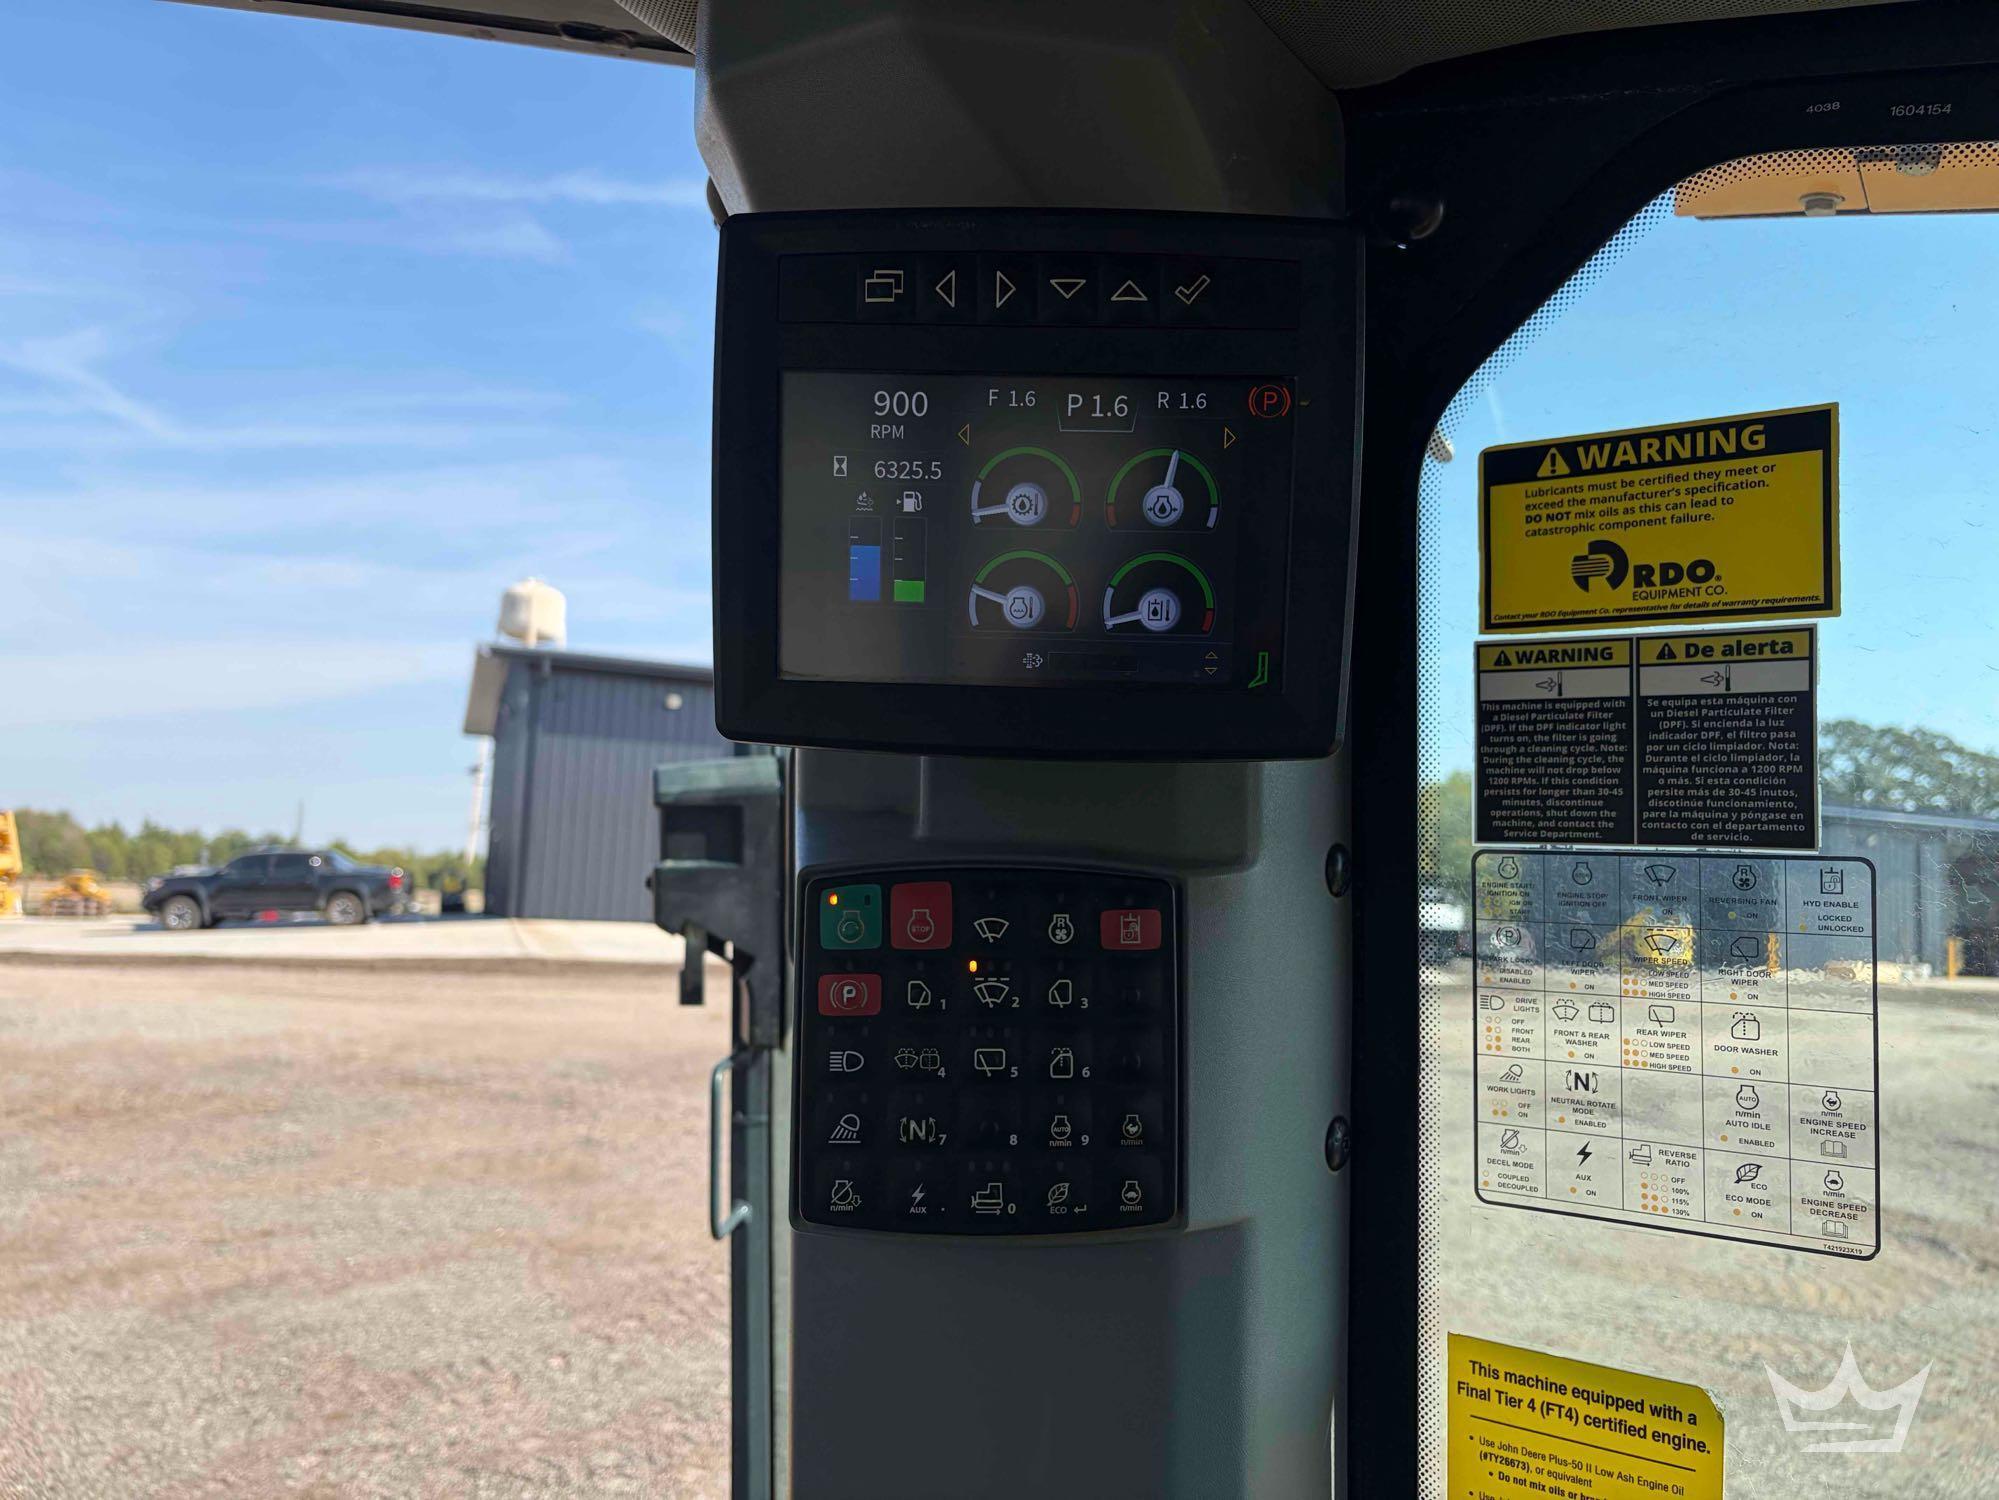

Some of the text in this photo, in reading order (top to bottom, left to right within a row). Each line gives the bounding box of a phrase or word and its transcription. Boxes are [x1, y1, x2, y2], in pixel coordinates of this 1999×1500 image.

[1806, 101, 1841, 114] 4038
[1890, 103, 1952, 117] 1604154
[872, 390, 929, 417] 900
[988, 389, 1036, 407] F 1.6
[1157, 391, 1208, 409] R 1.6
[1067, 394, 1129, 418] P 1.6
[870, 424, 904, 440] RPM
[1577, 424, 1766, 471] WARNING
[874, 460, 942, 480] 6325.5
[1525, 464, 1776, 498] Lubricants must be certified they meet or
[1525, 499, 1563, 511] exceed
[1567, 498, 1586, 507] the
[1685, 480, 1769, 496] specification.
[1525, 496, 1734, 524] DO NOT mix oils as this can lead to
[1525, 512, 1715, 537] catastrophic component failure.
[1633, 585, 1728, 601] EQUIPMENT CO.
[1558, 609, 1597, 617] Equipment
[1612, 605, 1668, 614] representative
[1683, 601, 1709, 609] details
[1722, 599, 1760, 607] warranty
[1761, 595, 1821, 605] requirements.
[1685, 640, 1793, 658] De alerta
[1515, 647, 1613, 664] WARNING
[1482, 703, 1500, 711] This
[1502, 702, 1541, 710] machine
[1555, 701, 1600, 710] equipped
[1603, 700, 1625, 708] with
[1662, 699, 1697, 707] equipa
[1727, 696, 1775, 705] máquina
[1531, 712, 1584, 720] Particulate
[1504, 830, 1602, 839] Service Department.
[1691, 832, 1752, 841] de servicio.
[1803, 900, 1859, 909] HYD ENABLE
[1818, 924, 1864, 933] UNLOCKED
[940, 999, 946, 1009] 1
[1012, 997, 1020, 1008] 2
[1081, 998, 1089, 1008] 3
[1714, 1045, 1778, 1056] DOOR WASHER
[938, 1067, 946, 1078] 4
[1011, 1067, 1018, 1078] 5
[1082, 1067, 1090, 1078] 6
[1574, 1072, 1590, 1091] N
[1487, 1085, 1536, 1096] WORK LIGHTS
[910, 1120, 926, 1140] N
[1725, 1119, 1771, 1130] AUTO IDLE
[1800, 1117, 1866, 1131] ENGINE SPEED
[938, 1134, 947, 1145] 7
[1810, 1128, 1856, 1139] INCREASE
[1010, 1135, 1018, 1145] 8
[1082, 1135, 1089, 1145] 9
[1738, 1137, 1775, 1148] ENABLED
[1487, 1158, 1534, 1170] DECEL MODE
[1498, 1172, 1530, 1182] COUPLED
[1498, 1181, 1539, 1193] DECOUPLED
[1751, 1183, 1767, 1191] ECO
[1725, 1194, 1771, 1206] ECO MODE
[1801, 1198, 1867, 1213] ENGINE SPEED
[830, 1204, 853, 1212] n/min
[1008, 1204, 1016, 1214] 0
[1120, 1204, 1142, 1212] n/min
[1810, 1208, 1858, 1221] DECREASE
[1469, 1360, 1697, 1426] This machine equipped with a
[1457, 1381, 1710, 1454] Final Tier 4 (FT4) certified engine.
[1479, 1436, 1684, 1496] Use John Deere Plus-50 II Low Ash Engine Oil
[1535, 1466, 1544, 1475] or
[1547, 1471, 1592, 1487] equivalent
[1498, 1471, 1510, 1482] Do
[1513, 1477, 1526, 1487] not
[1530, 1481, 1546, 1491] mix
[1549, 1485, 1565, 1496] oils
[1568, 1490, 1577, 1500] or
